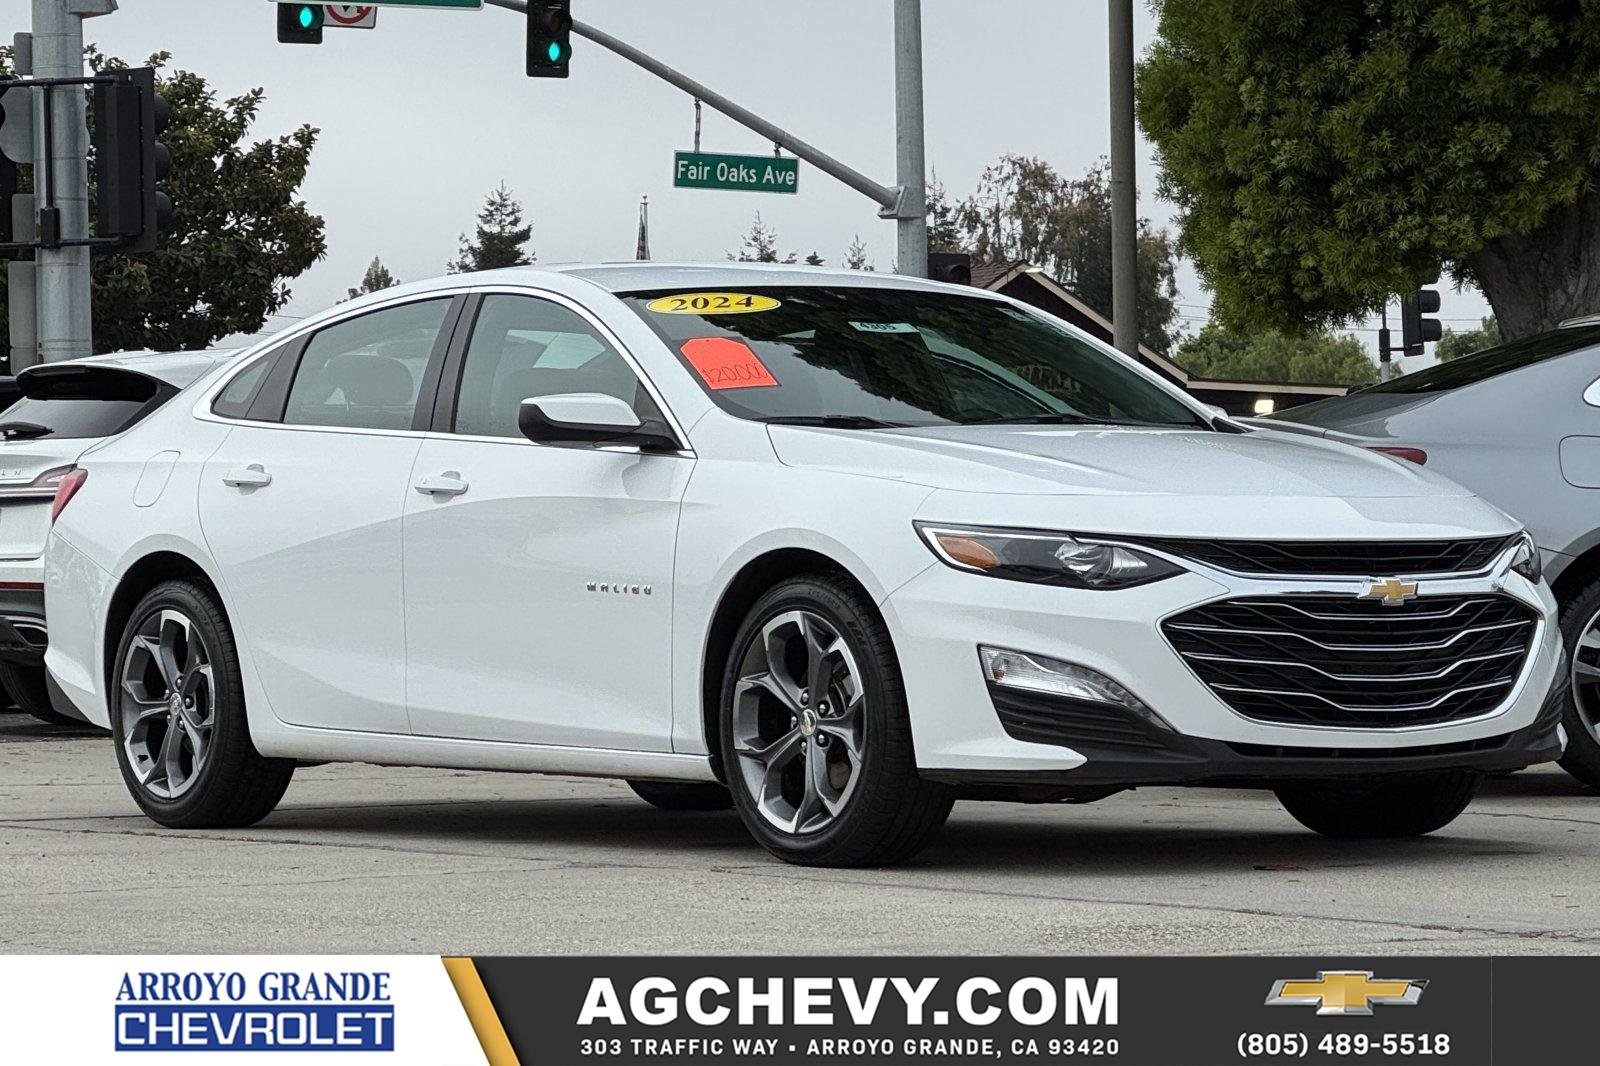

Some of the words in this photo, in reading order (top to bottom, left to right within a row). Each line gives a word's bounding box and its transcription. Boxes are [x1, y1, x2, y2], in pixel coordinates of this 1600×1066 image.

[677, 160, 711, 181] Fair
[716, 162, 757, 184] Oaks
[762, 165, 796, 186] Ave
[670, 296, 755, 312] 2024
[586, 580, 653, 596] MALIBU
